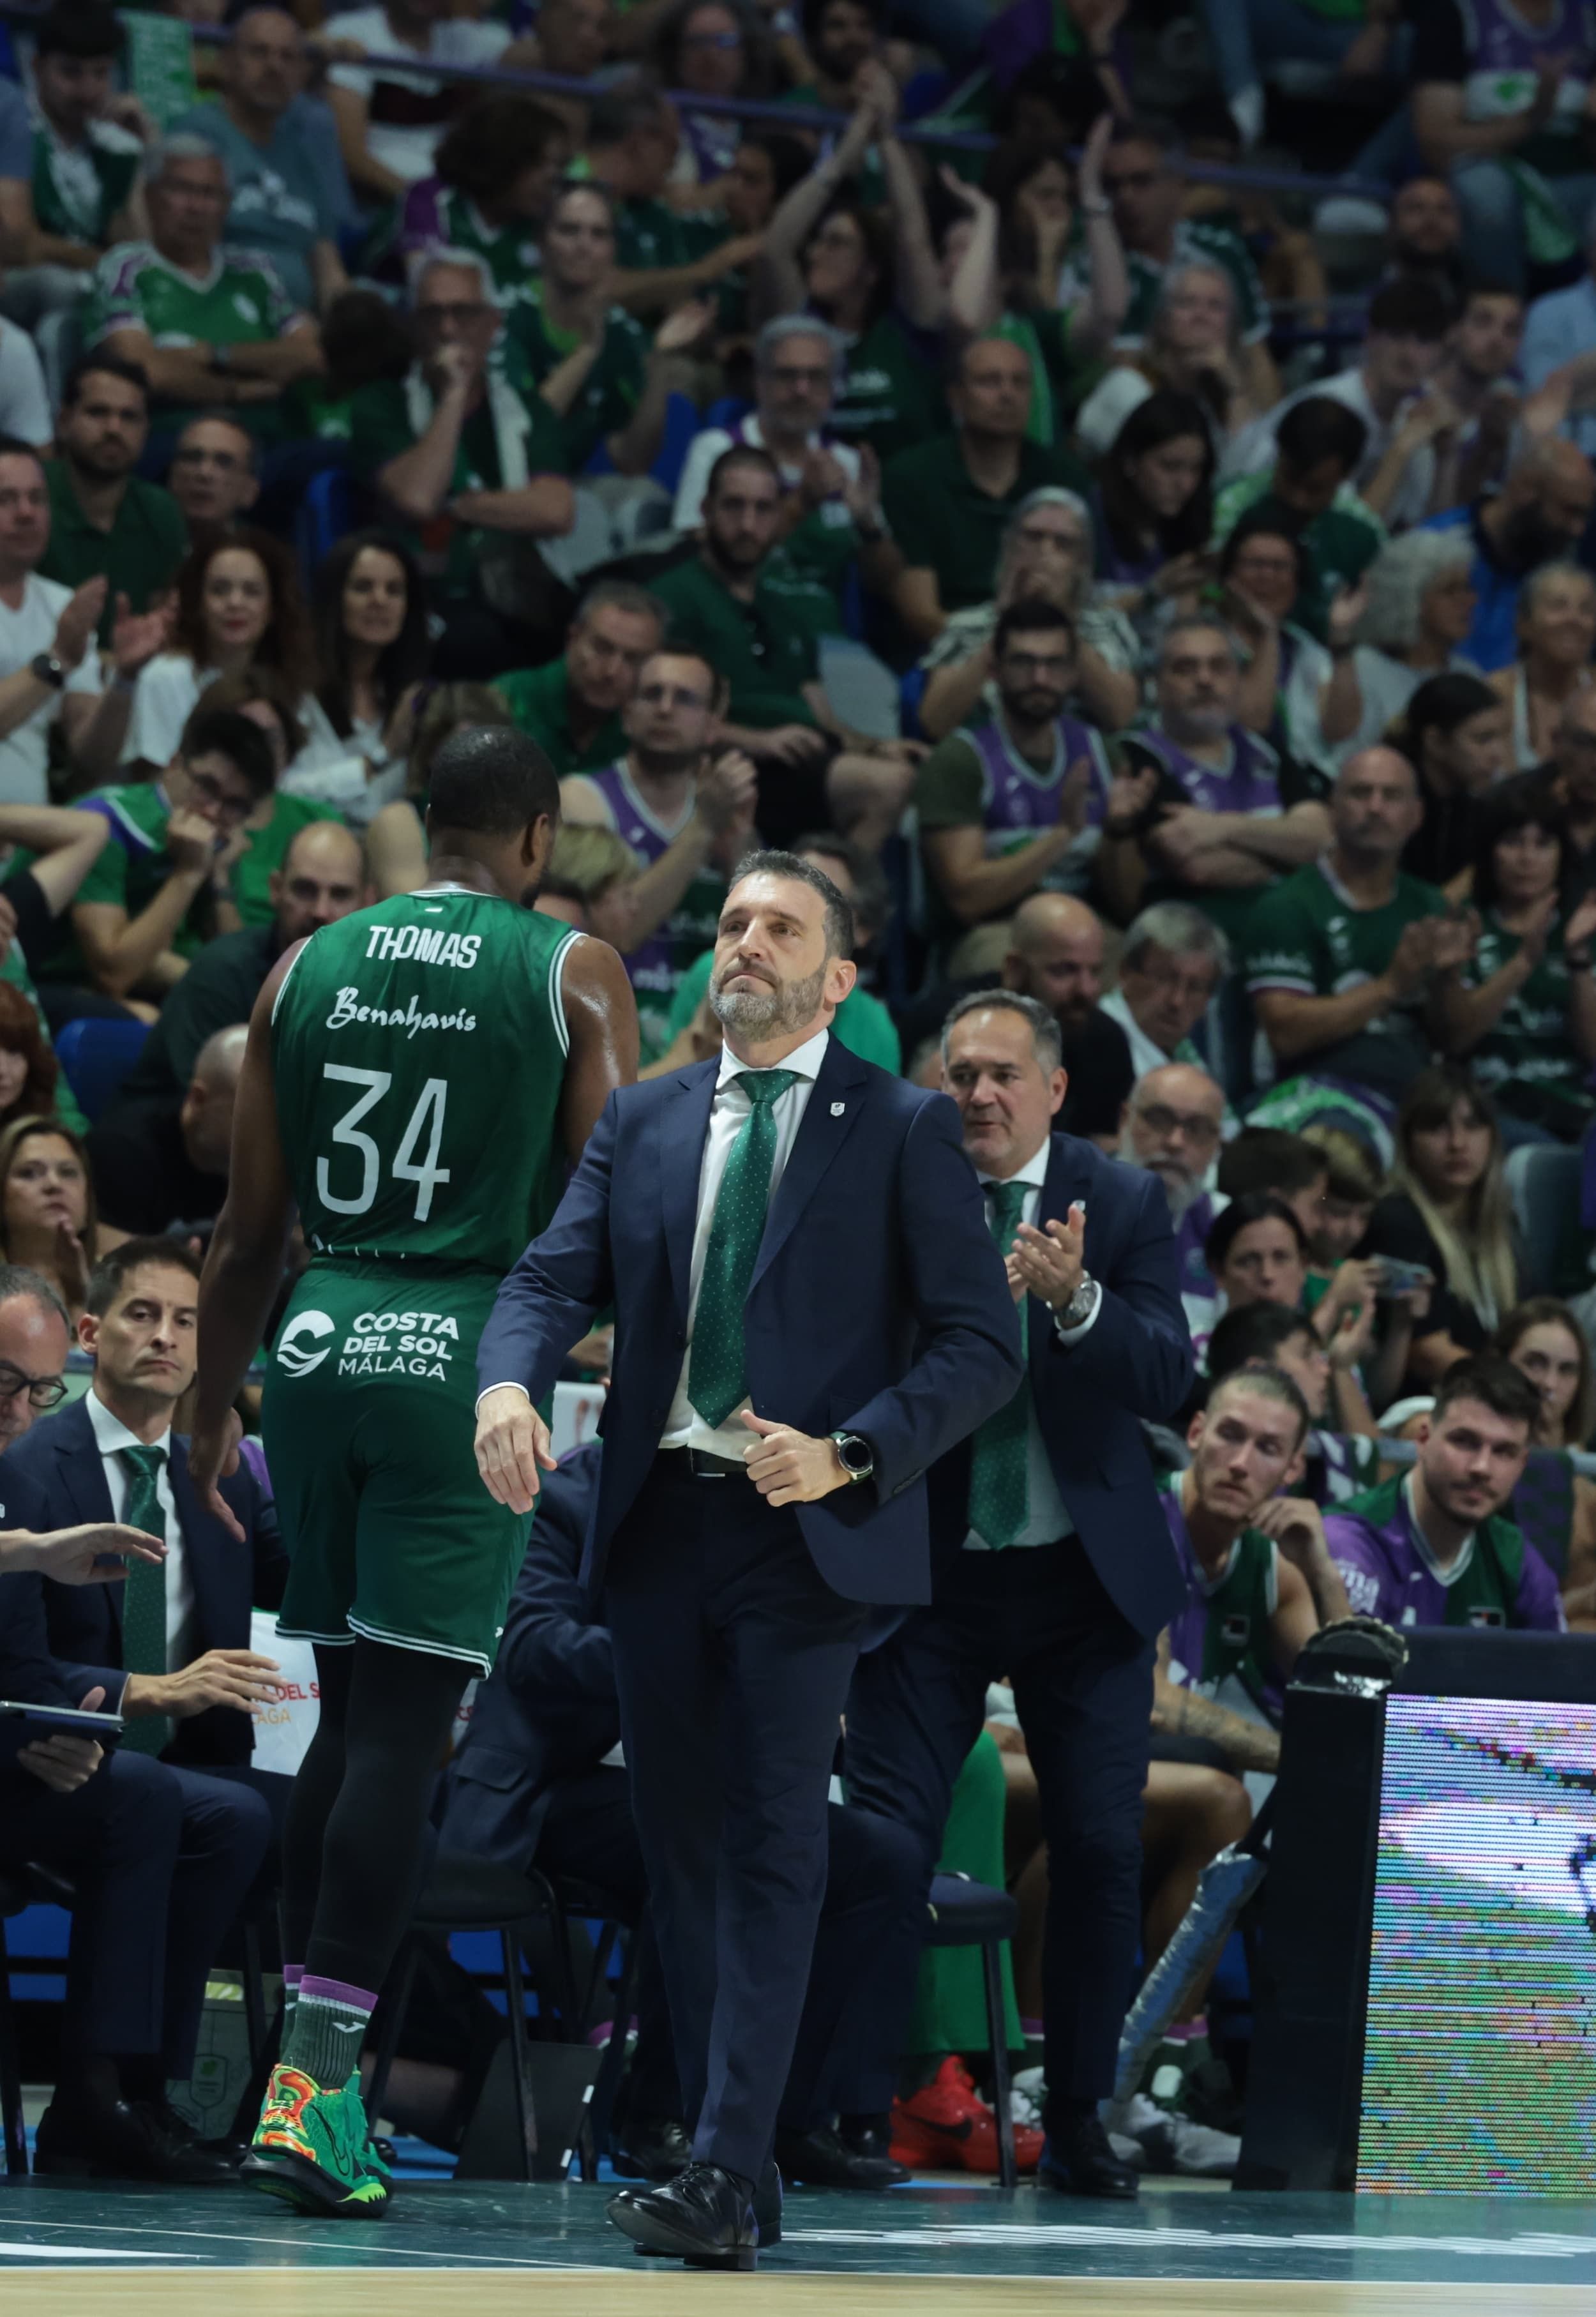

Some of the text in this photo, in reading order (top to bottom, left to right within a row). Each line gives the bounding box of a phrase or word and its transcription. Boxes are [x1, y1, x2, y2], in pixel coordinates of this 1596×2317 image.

[365, 925, 482, 969] THOMAS
[317, 1062, 450, 1222] 34
[353, 1312, 459, 1340] COSTA
[343, 1335, 452, 1361] DEL SOL
[338, 1354, 446, 1382] MÁLAGA
